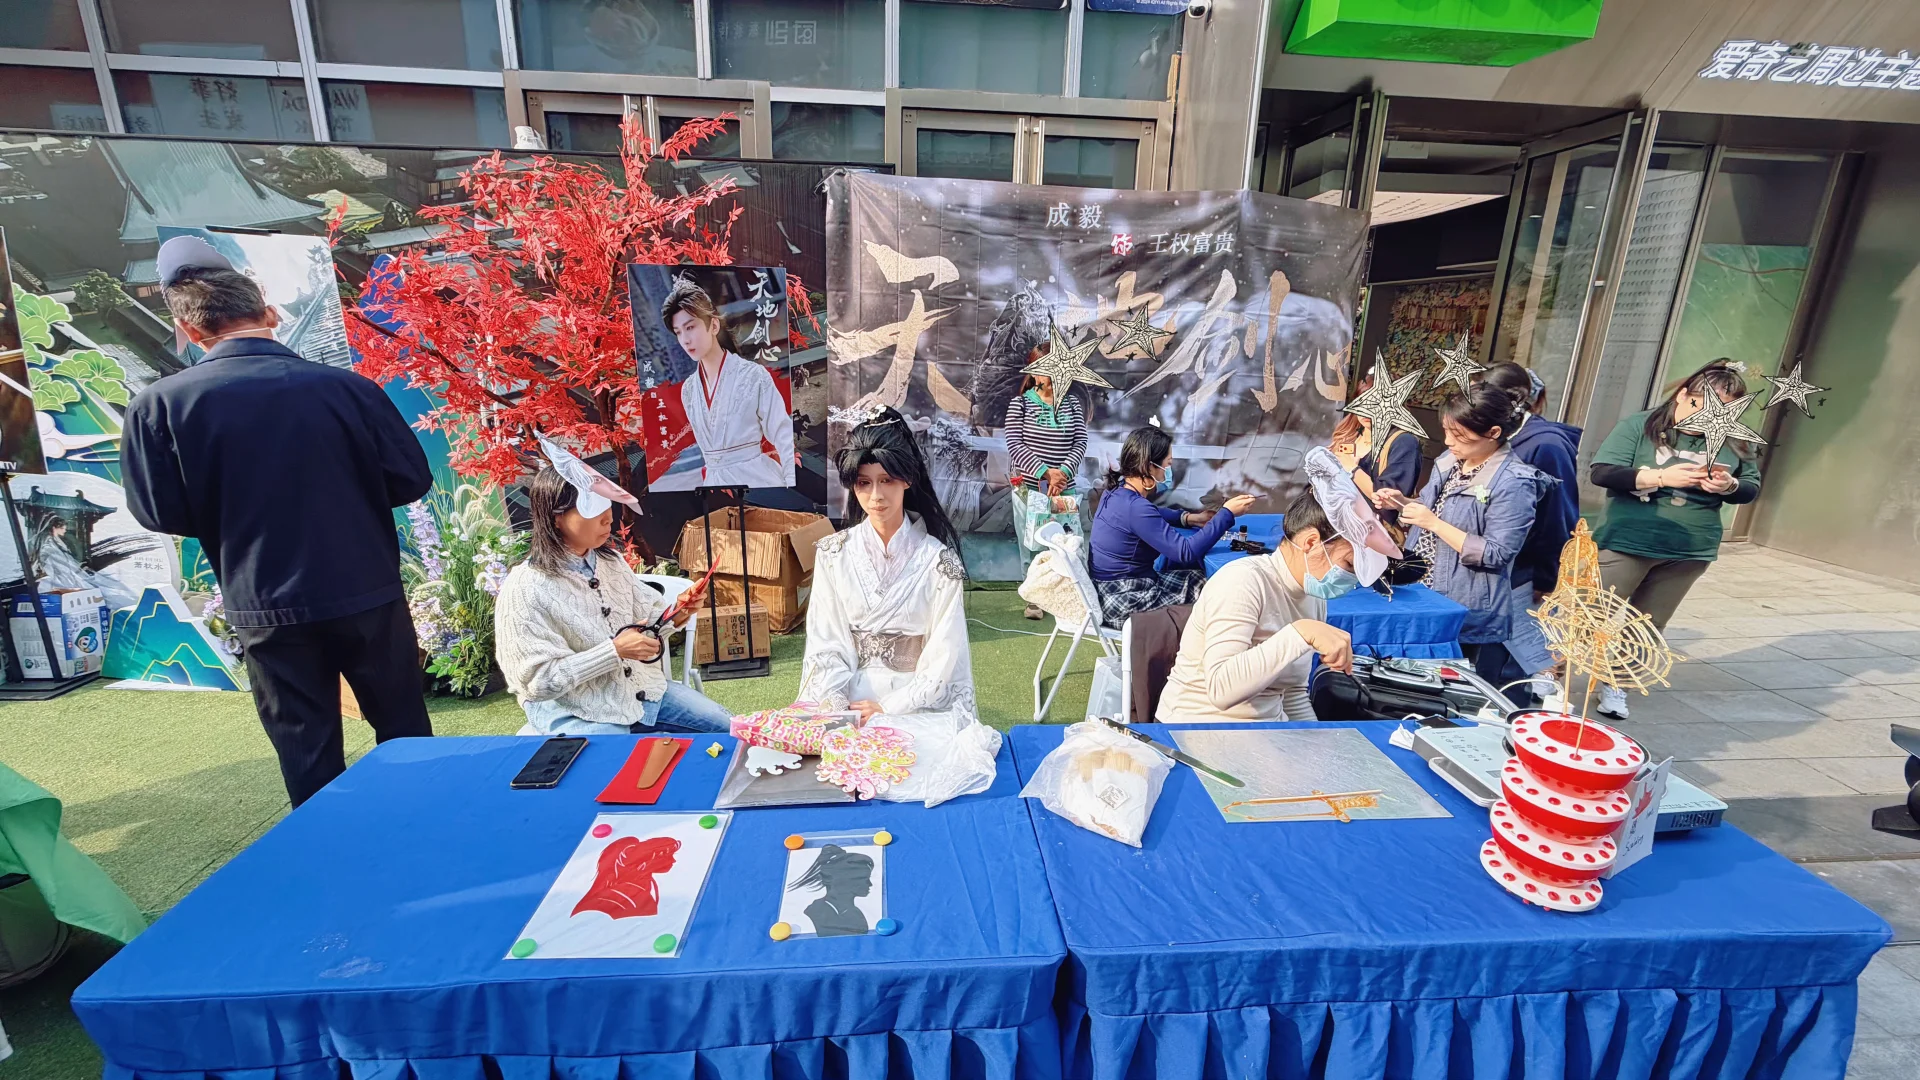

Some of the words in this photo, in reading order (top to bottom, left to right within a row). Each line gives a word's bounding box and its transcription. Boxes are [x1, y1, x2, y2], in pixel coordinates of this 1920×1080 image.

[1046, 202, 1102, 229] 成毅
[1147, 231, 1235, 255] 王权富贵
[741, 269, 782, 362] 天地剑心
